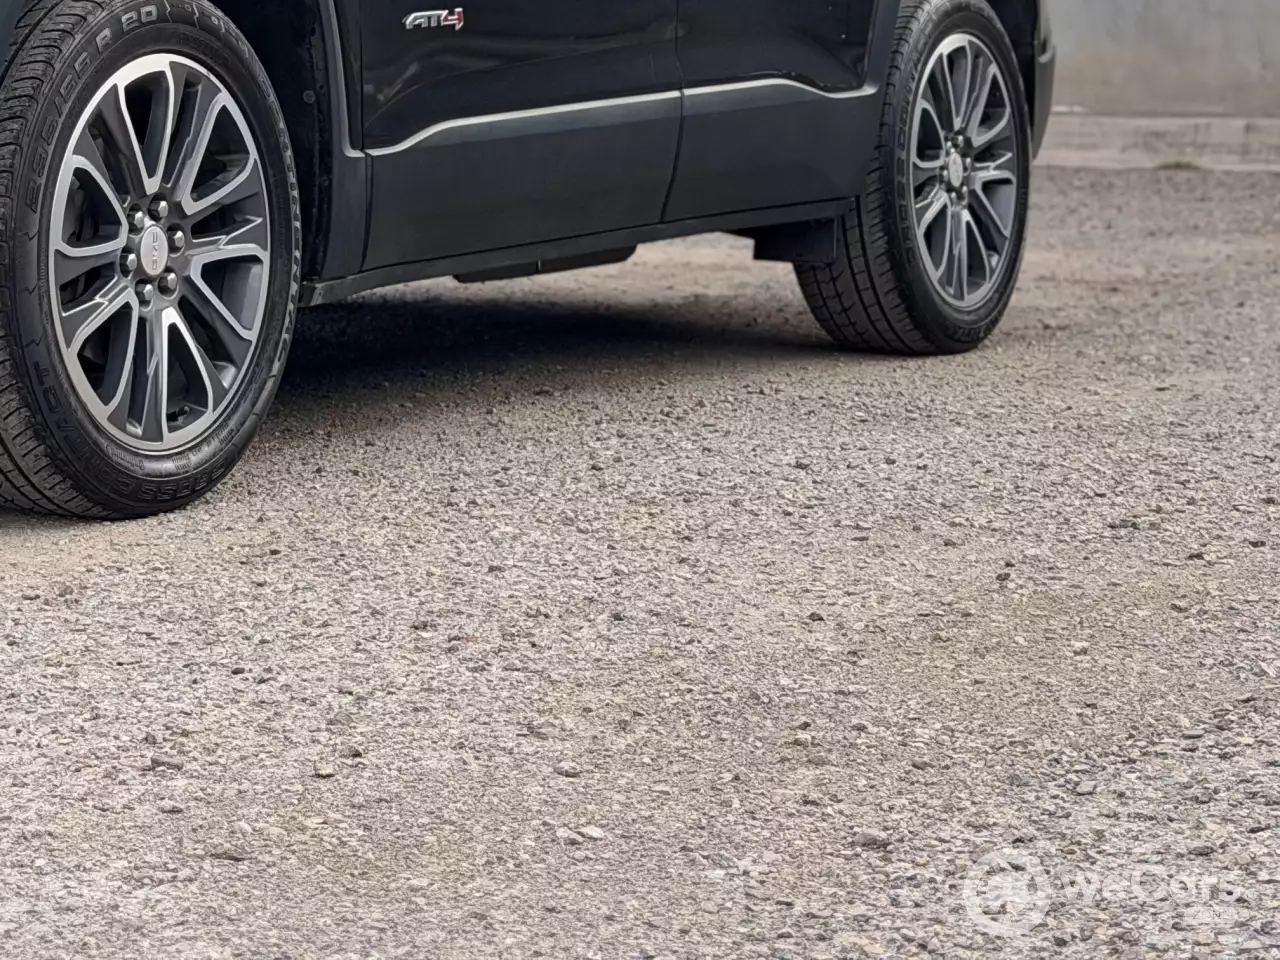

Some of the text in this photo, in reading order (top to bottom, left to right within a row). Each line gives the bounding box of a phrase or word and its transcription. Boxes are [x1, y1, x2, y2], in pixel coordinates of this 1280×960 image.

[95, 26, 113, 55] R
[120, 3, 158, 34] 20
[404, 7, 463, 31] AT4
